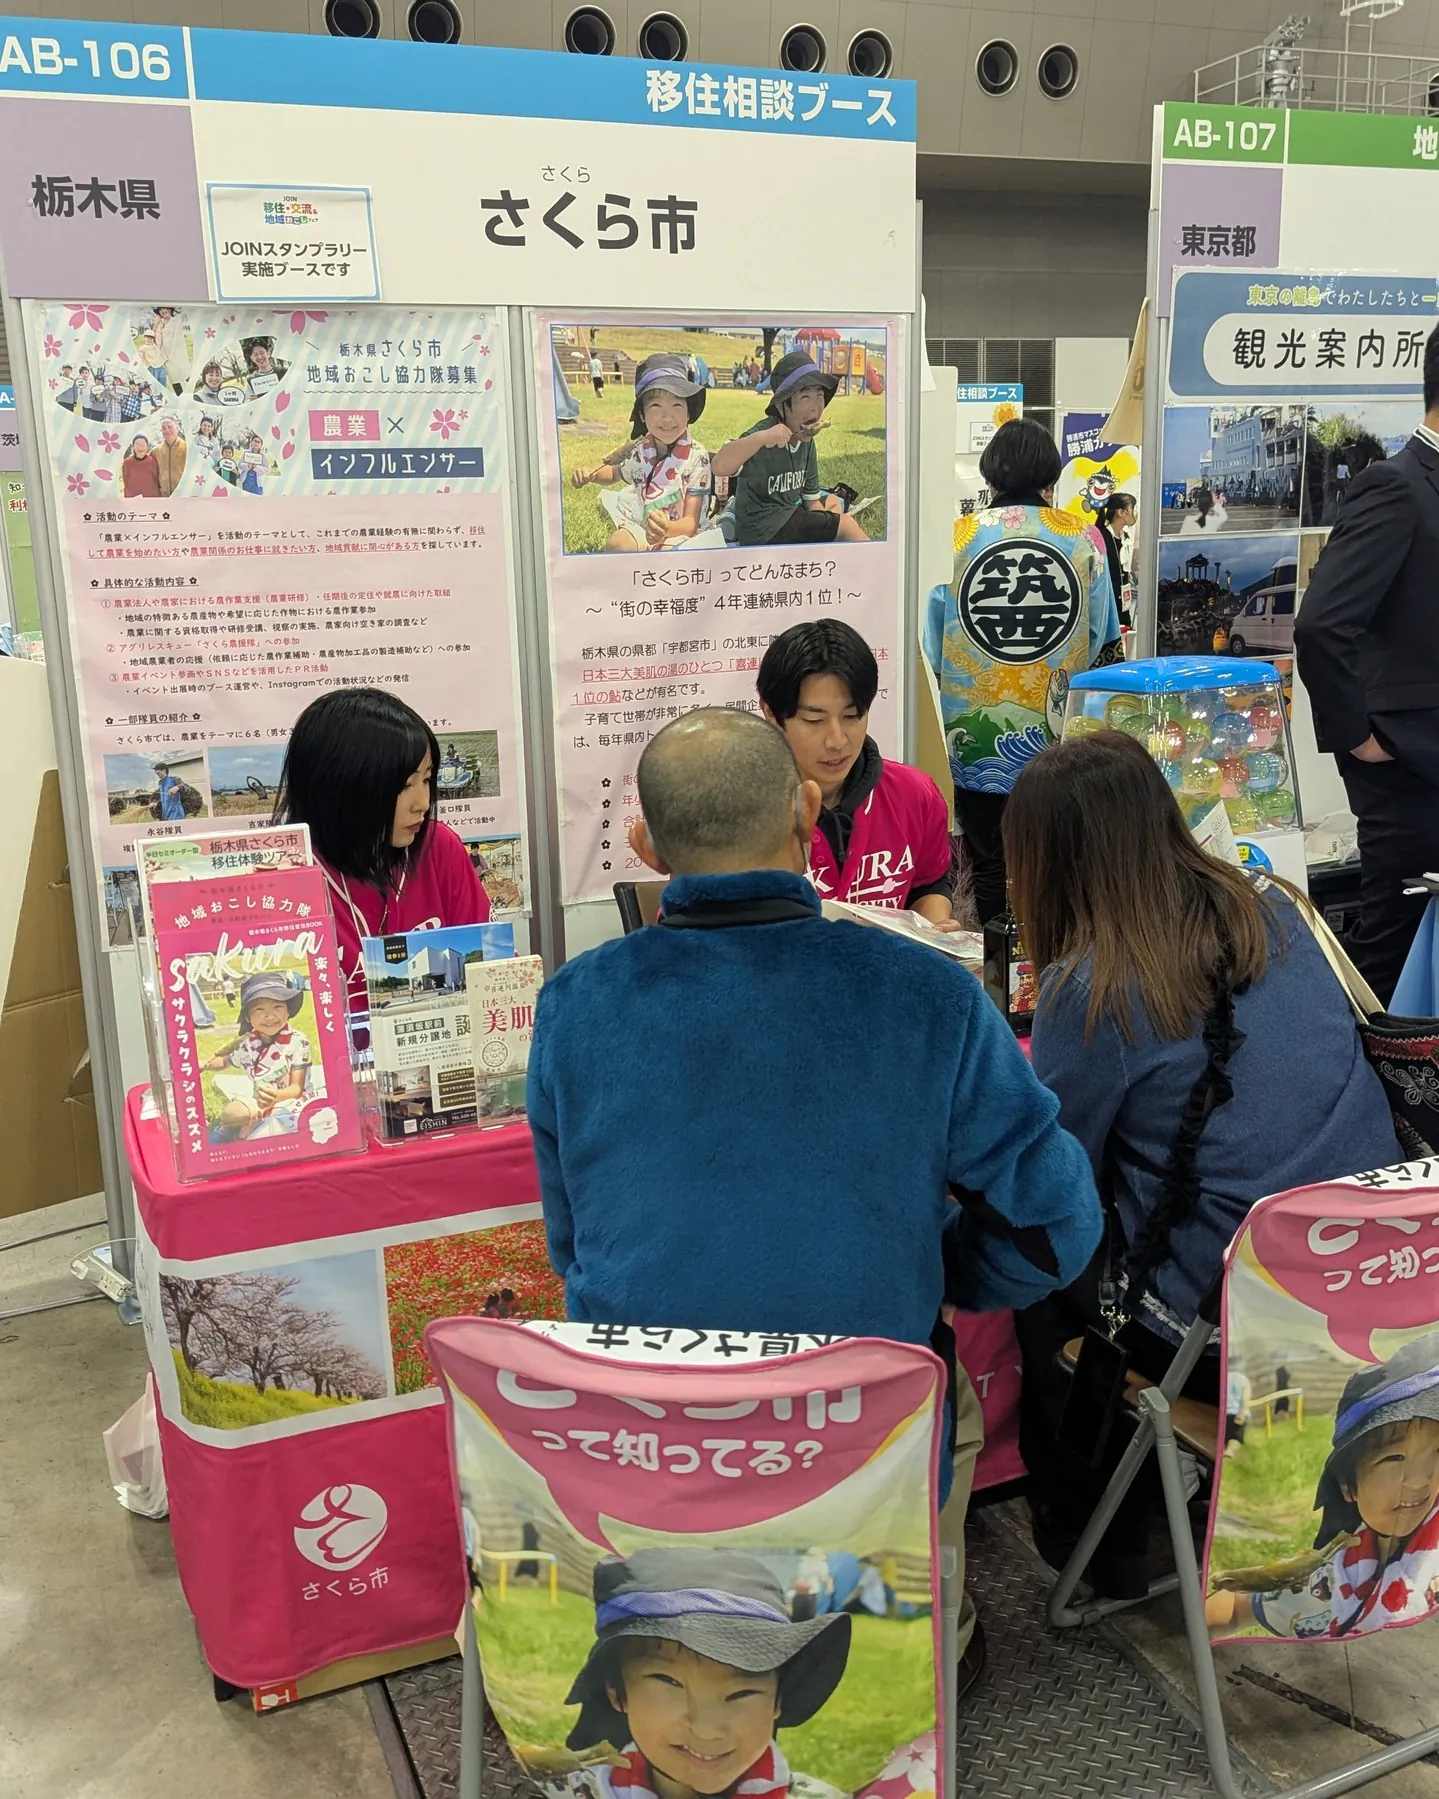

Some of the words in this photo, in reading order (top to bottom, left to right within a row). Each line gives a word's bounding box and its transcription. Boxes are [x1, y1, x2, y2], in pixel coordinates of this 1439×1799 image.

[0, 35, 172, 82] AB-106
[645, 69, 897, 127] 移住相談ブース
[1172, 118, 1277, 152] AB-107
[1412, 124, 1439, 161] 地
[540, 165, 592, 184] さくら
[31, 174, 162, 221] 栃木県
[479, 189, 699, 255] さくら市
[220, 239, 367, 259] JOINスタンプラリー
[1180, 224, 1257, 258] 東京都
[241, 260, 351, 278] 実施ブースです
[338, 339, 443, 359] 栃木県さくら市
[1232, 327, 1425, 370] 観光案内所
[305, 364, 478, 386] 地域おこし協力隊募集
[323, 414, 368, 438] 農業
[1067, 438, 1113, 457] 勝浦カ
[319, 452, 477, 477] インフルエンサー
[96, 512, 158, 522] 活動のテーマ
[103, 576, 186, 589] 具体的な活動内容
[968, 553, 1071, 649] 筑西
[117, 712, 189, 725] 一部隊員の紹介
[440, 816, 496, 827] 人などで活動中
[209, 833, 299, 855] 栃木県さくら市
[174, 894, 313, 930] 地域おこし協力隊
[482, 1004, 534, 1036] 美肌
[301, 1566, 390, 1602] さくら市
